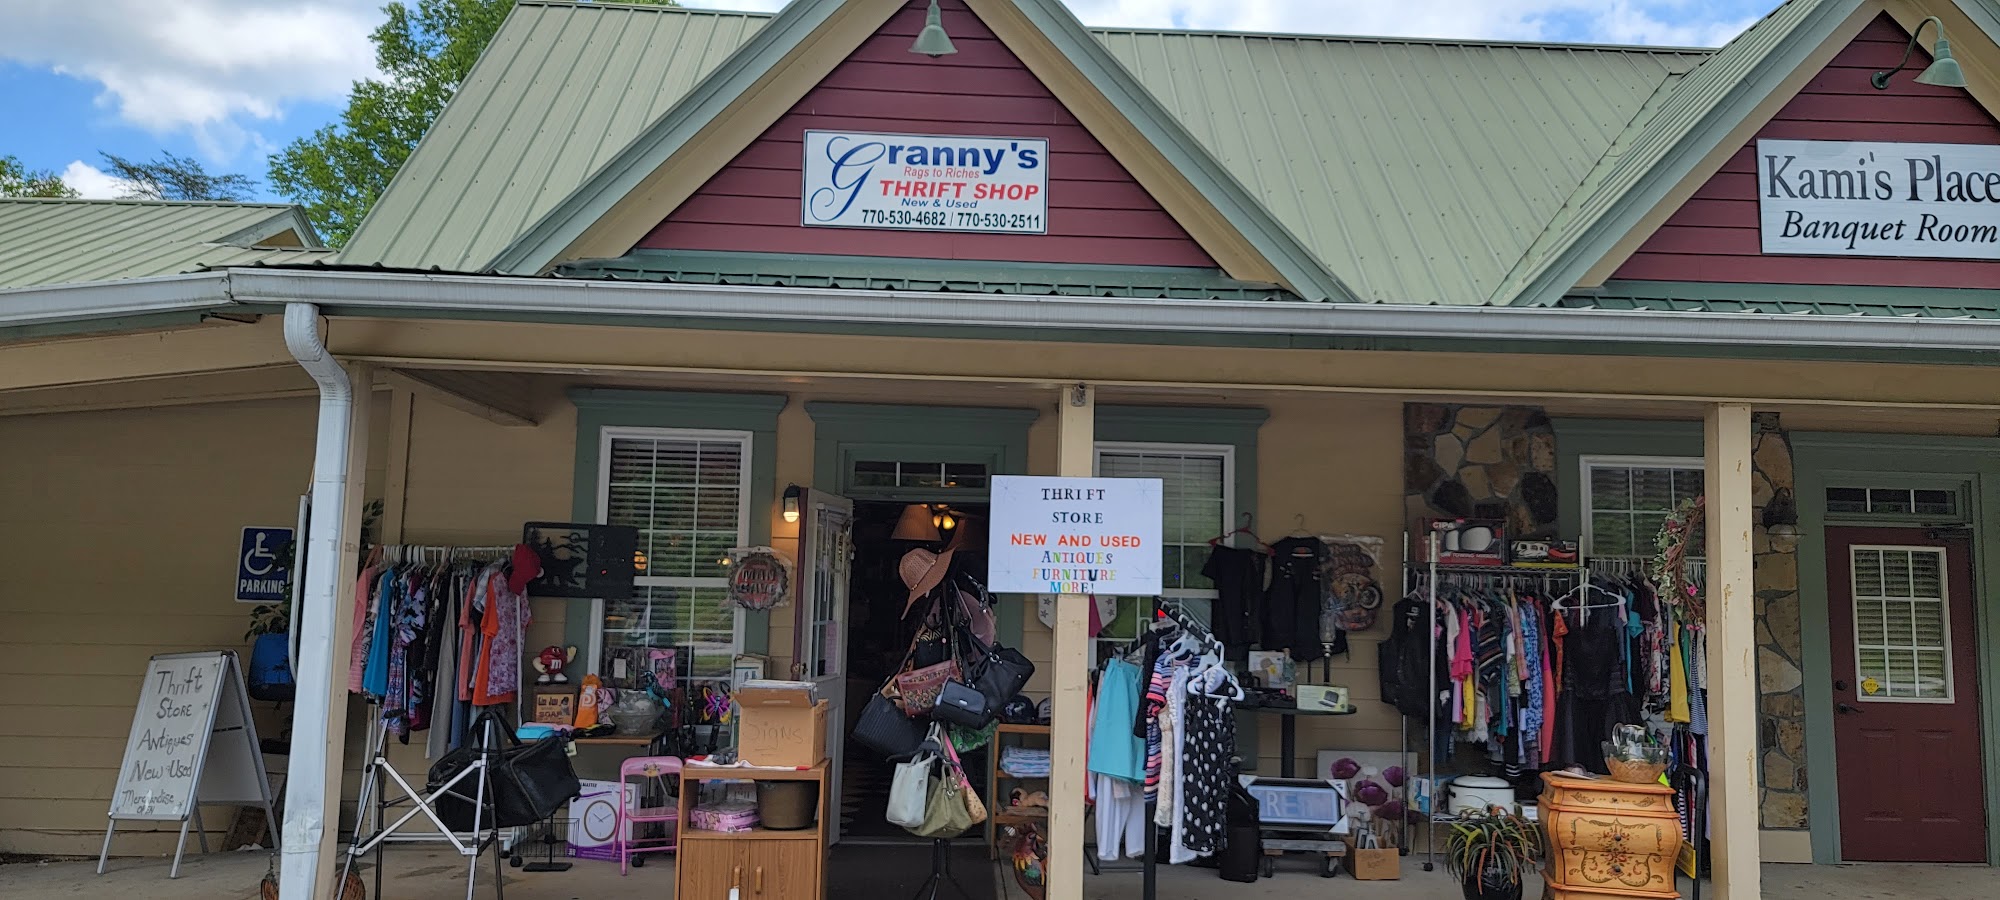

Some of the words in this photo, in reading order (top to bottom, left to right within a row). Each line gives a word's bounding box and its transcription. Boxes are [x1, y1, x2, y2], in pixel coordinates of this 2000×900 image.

[903, 166, 929, 180] Rags
[933, 168, 942, 178] to
[945, 168, 980, 179] Riches
[1764, 151, 1893, 200] Kami's
[880, 180, 967, 199] THRIFT
[973, 184, 1039, 201] SHOP
[901, 197, 928, 208] New
[933, 199, 941, 208] &
[946, 200, 978, 209] Used
[862, 209, 946, 226] 770-530-4682
[957, 212, 1040, 229] 770-530-2511
[1780, 210, 1907, 250] Banquet
[1915, 213, 1998, 243] Room
[1041, 488, 1106, 500] THRIFT
[1052, 512, 1104, 524] STORE
[1433, 521, 1454, 529] CIPA
[1011, 533, 1047, 546] NEW
[1058, 535, 1091, 547] AND
[1100, 535, 1141, 548] USED
[1041, 551, 1113, 565] ANTIQUES
[742, 569, 774, 581] MAN
[1032, 568, 1117, 582] FURNITURE
[1050, 582, 1094, 593] MORE!
[157, 666, 202, 695] Thrift
[129, 759, 163, 782] New
[169, 754, 195, 779] Used
